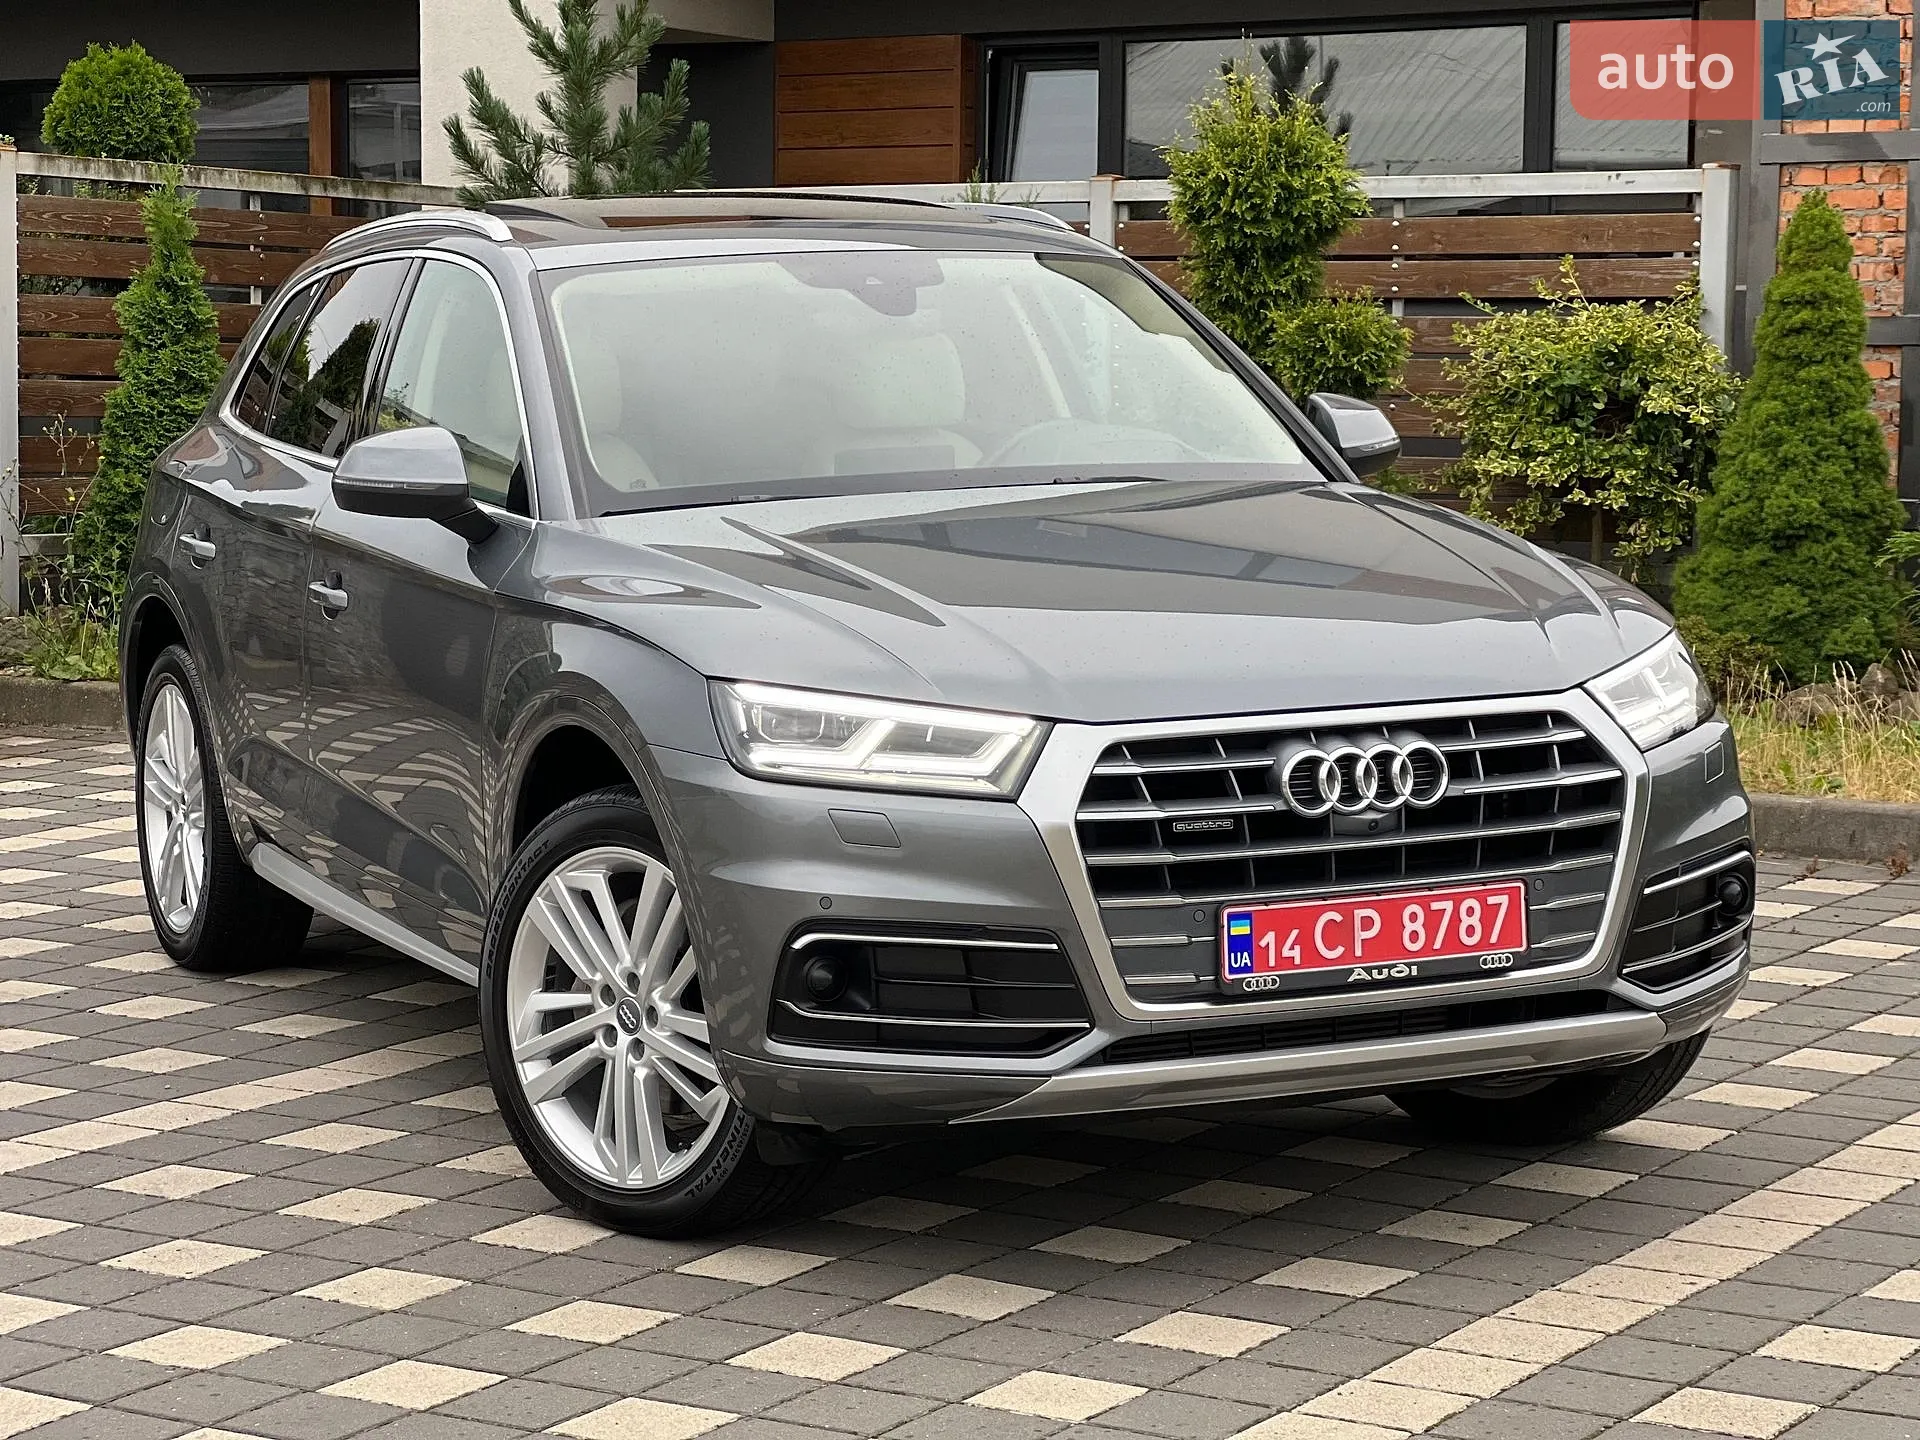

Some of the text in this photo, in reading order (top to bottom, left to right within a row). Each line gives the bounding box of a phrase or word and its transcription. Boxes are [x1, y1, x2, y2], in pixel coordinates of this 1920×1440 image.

[1176, 821, 1231, 831] quattro
[1258, 894, 1510, 968] 14 CP 8787
[1230, 951, 1251, 968] UA
